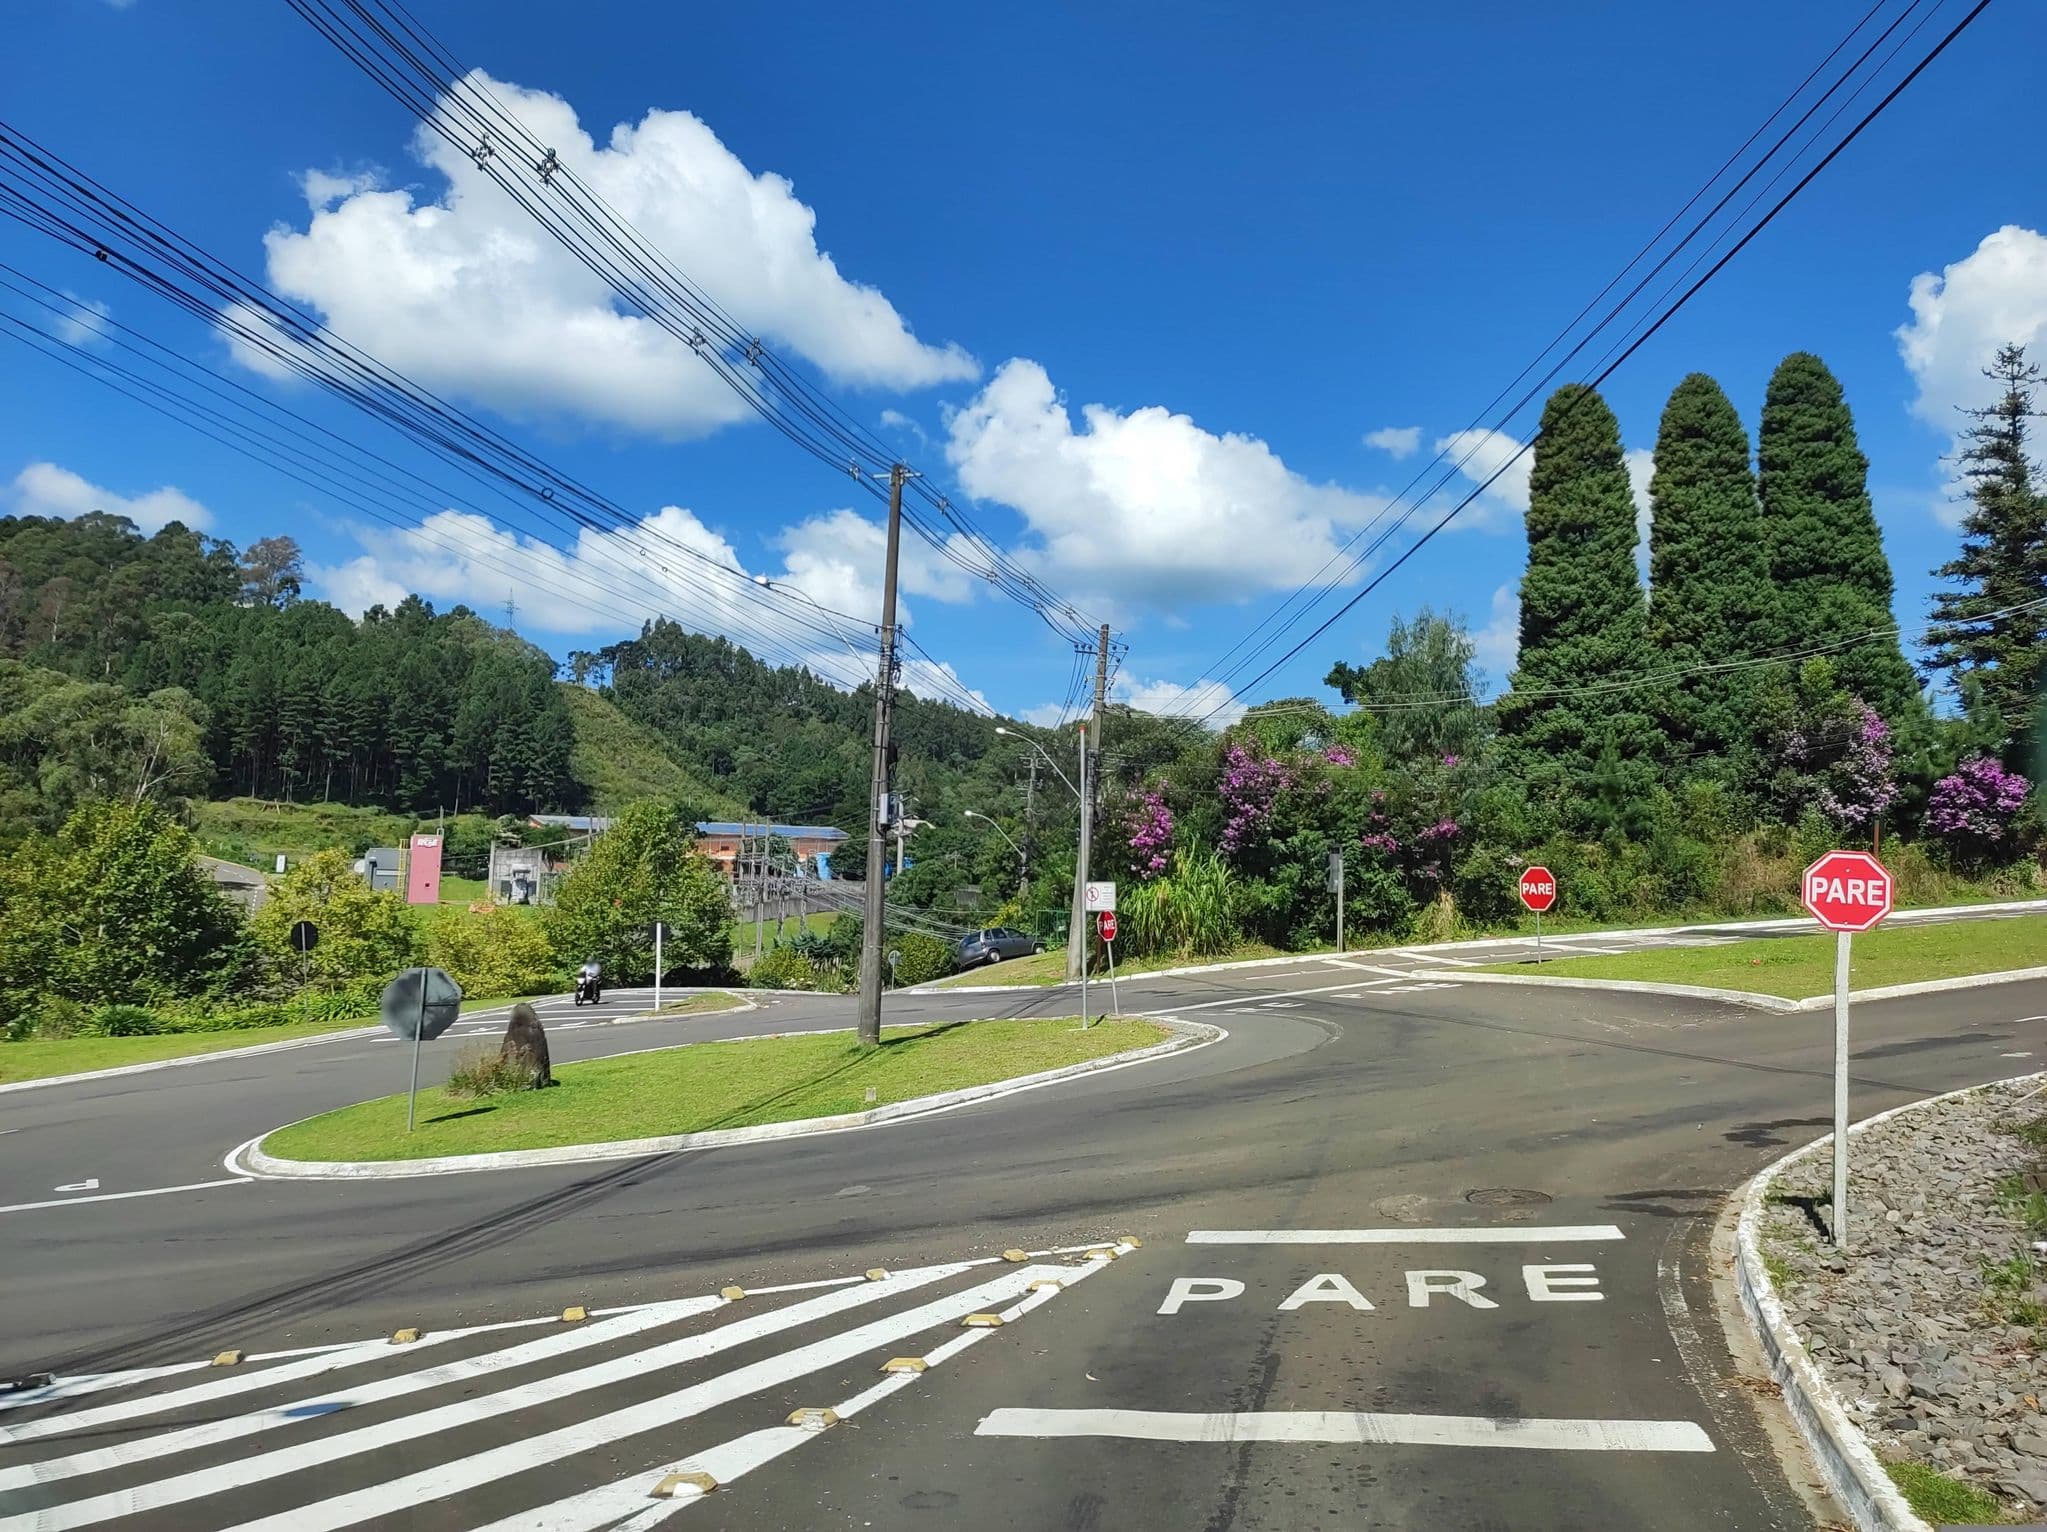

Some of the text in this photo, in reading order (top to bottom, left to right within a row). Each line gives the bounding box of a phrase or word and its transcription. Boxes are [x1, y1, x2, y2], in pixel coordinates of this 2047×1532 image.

[1522, 882, 1553, 895] PARE
[1811, 876, 1885, 906] PARE
[1156, 1264, 1604, 1315] PARE
